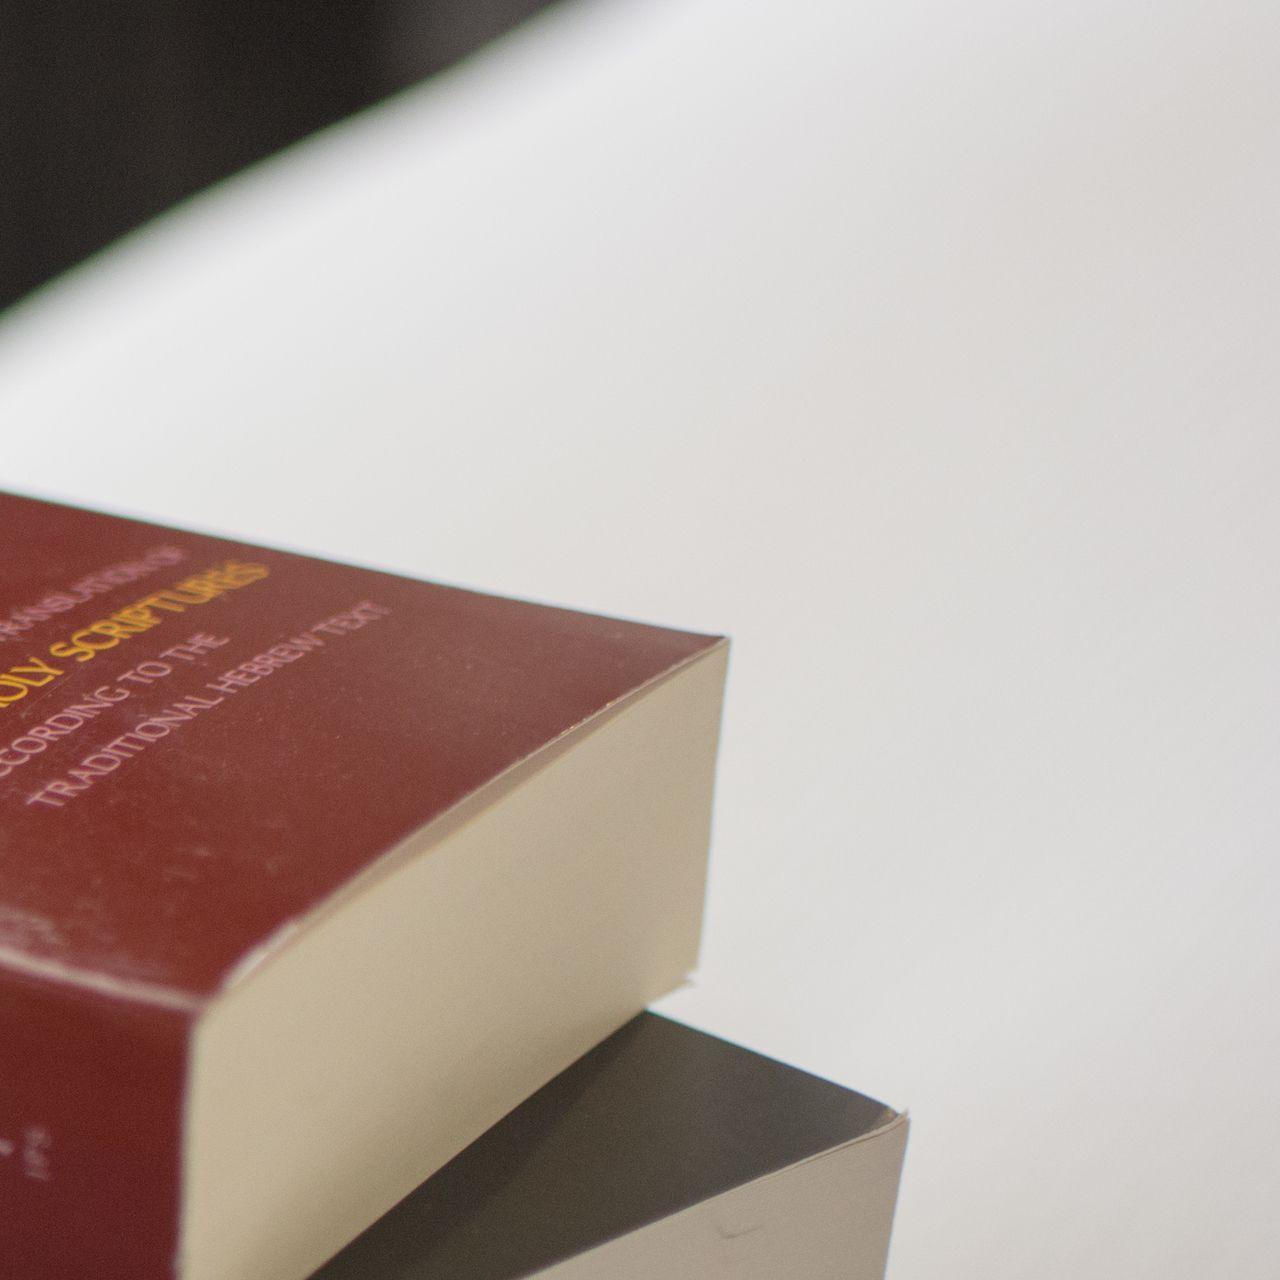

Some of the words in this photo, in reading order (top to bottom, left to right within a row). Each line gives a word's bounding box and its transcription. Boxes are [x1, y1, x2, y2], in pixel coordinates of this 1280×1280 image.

[49, 559, 271, 663] SCRIPTURES
[116, 660, 173, 685] TO
[158, 631, 232, 662] THE
[26, 693, 226, 807] TRADITIONAL
[205, 631, 327, 696] HEBREW
[312, 600, 392, 637] TEXT
